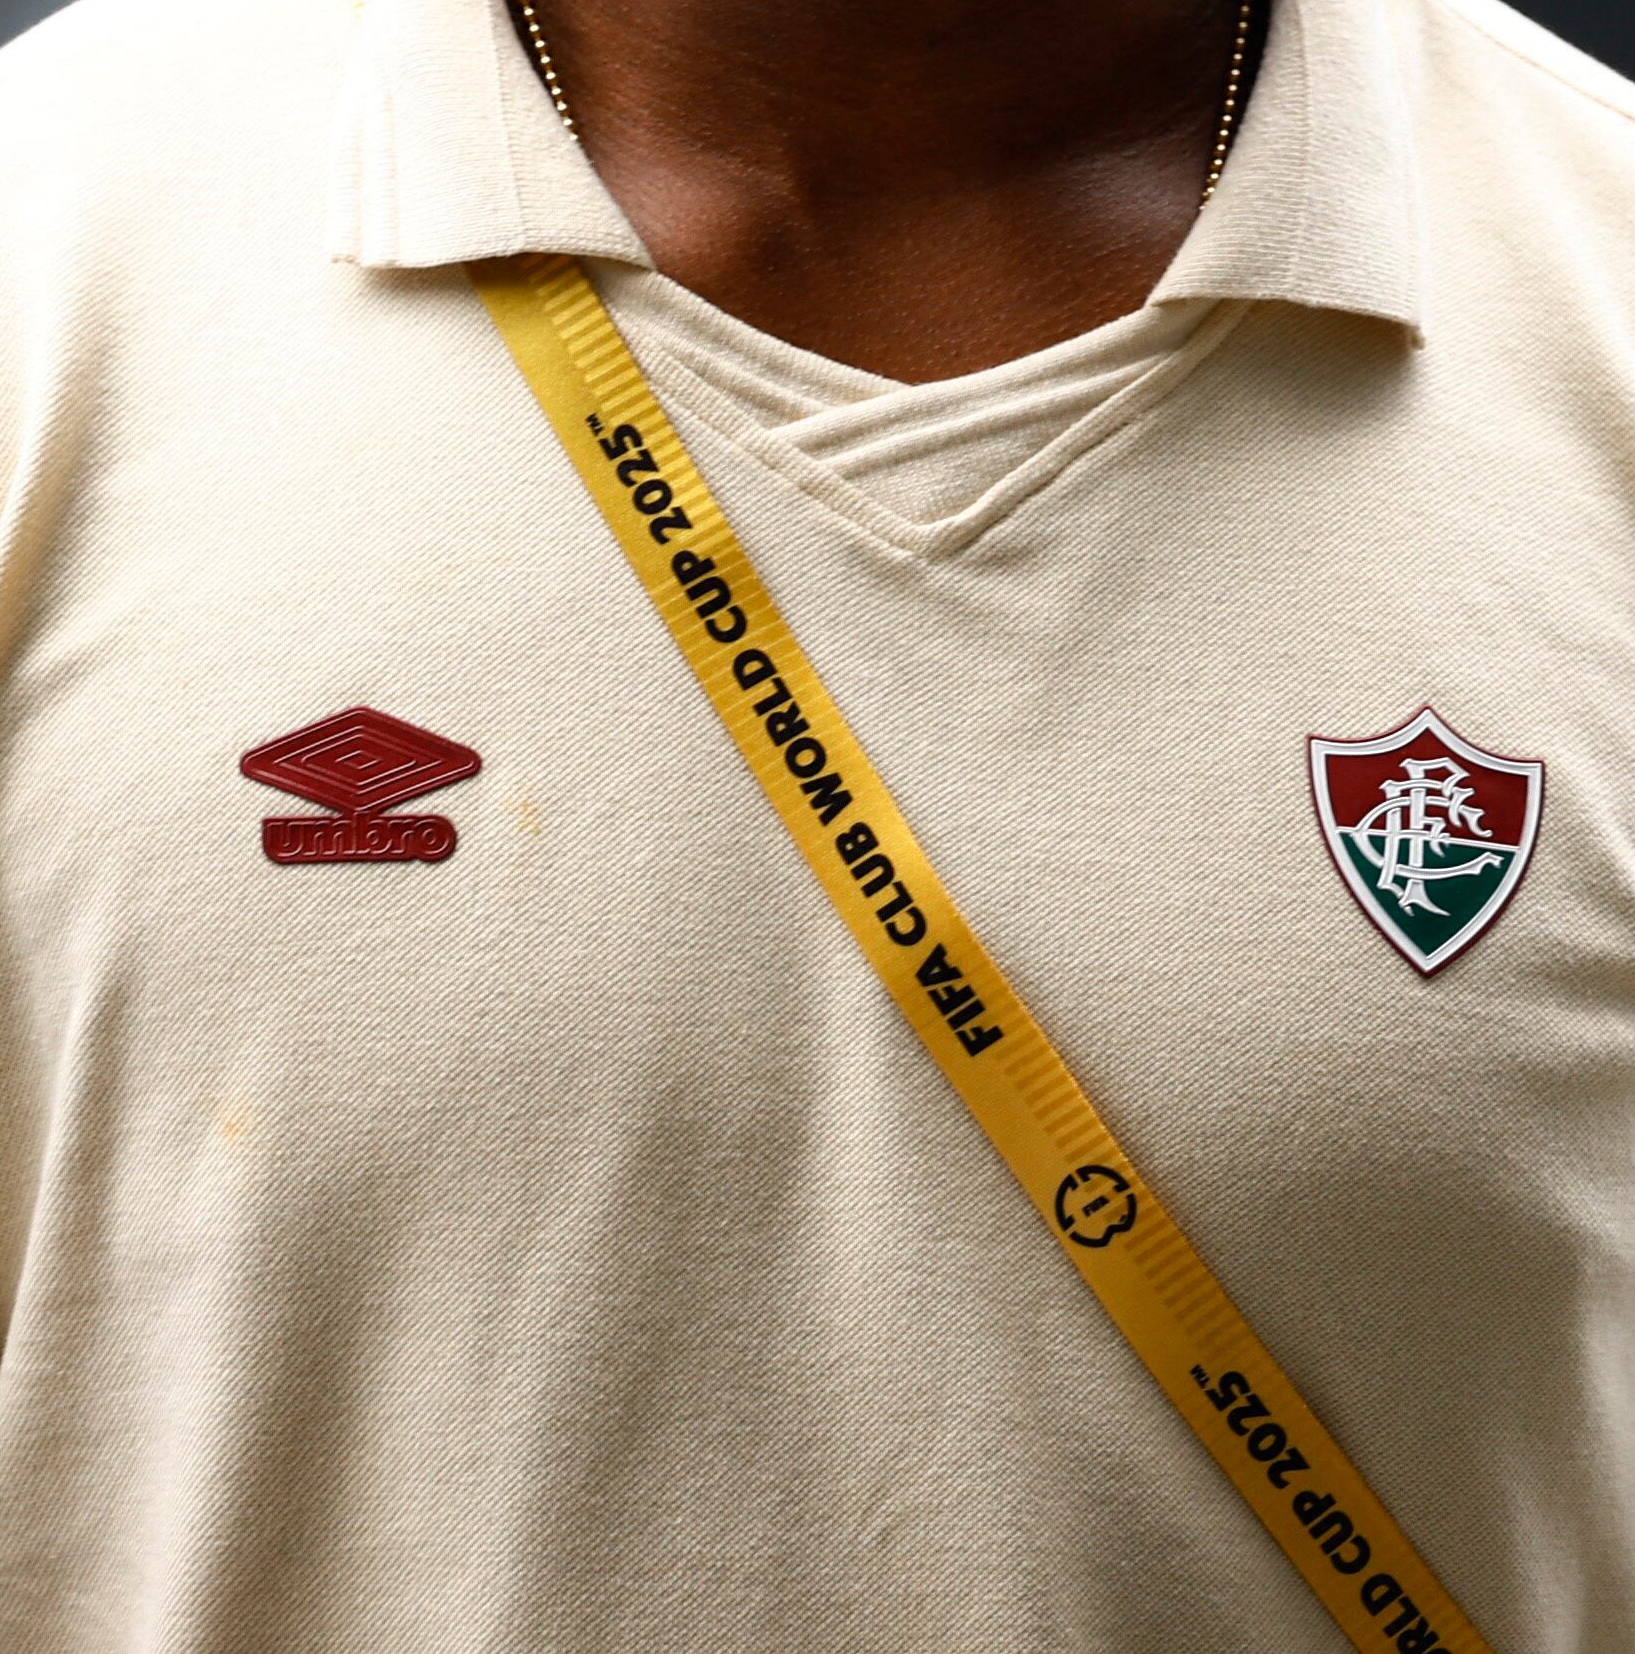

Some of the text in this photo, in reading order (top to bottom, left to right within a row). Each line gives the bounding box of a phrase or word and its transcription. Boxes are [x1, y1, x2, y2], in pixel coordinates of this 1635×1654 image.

[671, 550, 747, 643] CUP
[732, 649, 853, 826] WORLD
[264, 812, 452, 859] umbro
[835, 822, 927, 947] CLUB
[915, 943, 1004, 1057] FIFA
[1291, 1489, 1372, 1575] CUP
[1360, 1572, 1453, 1654] RLD
